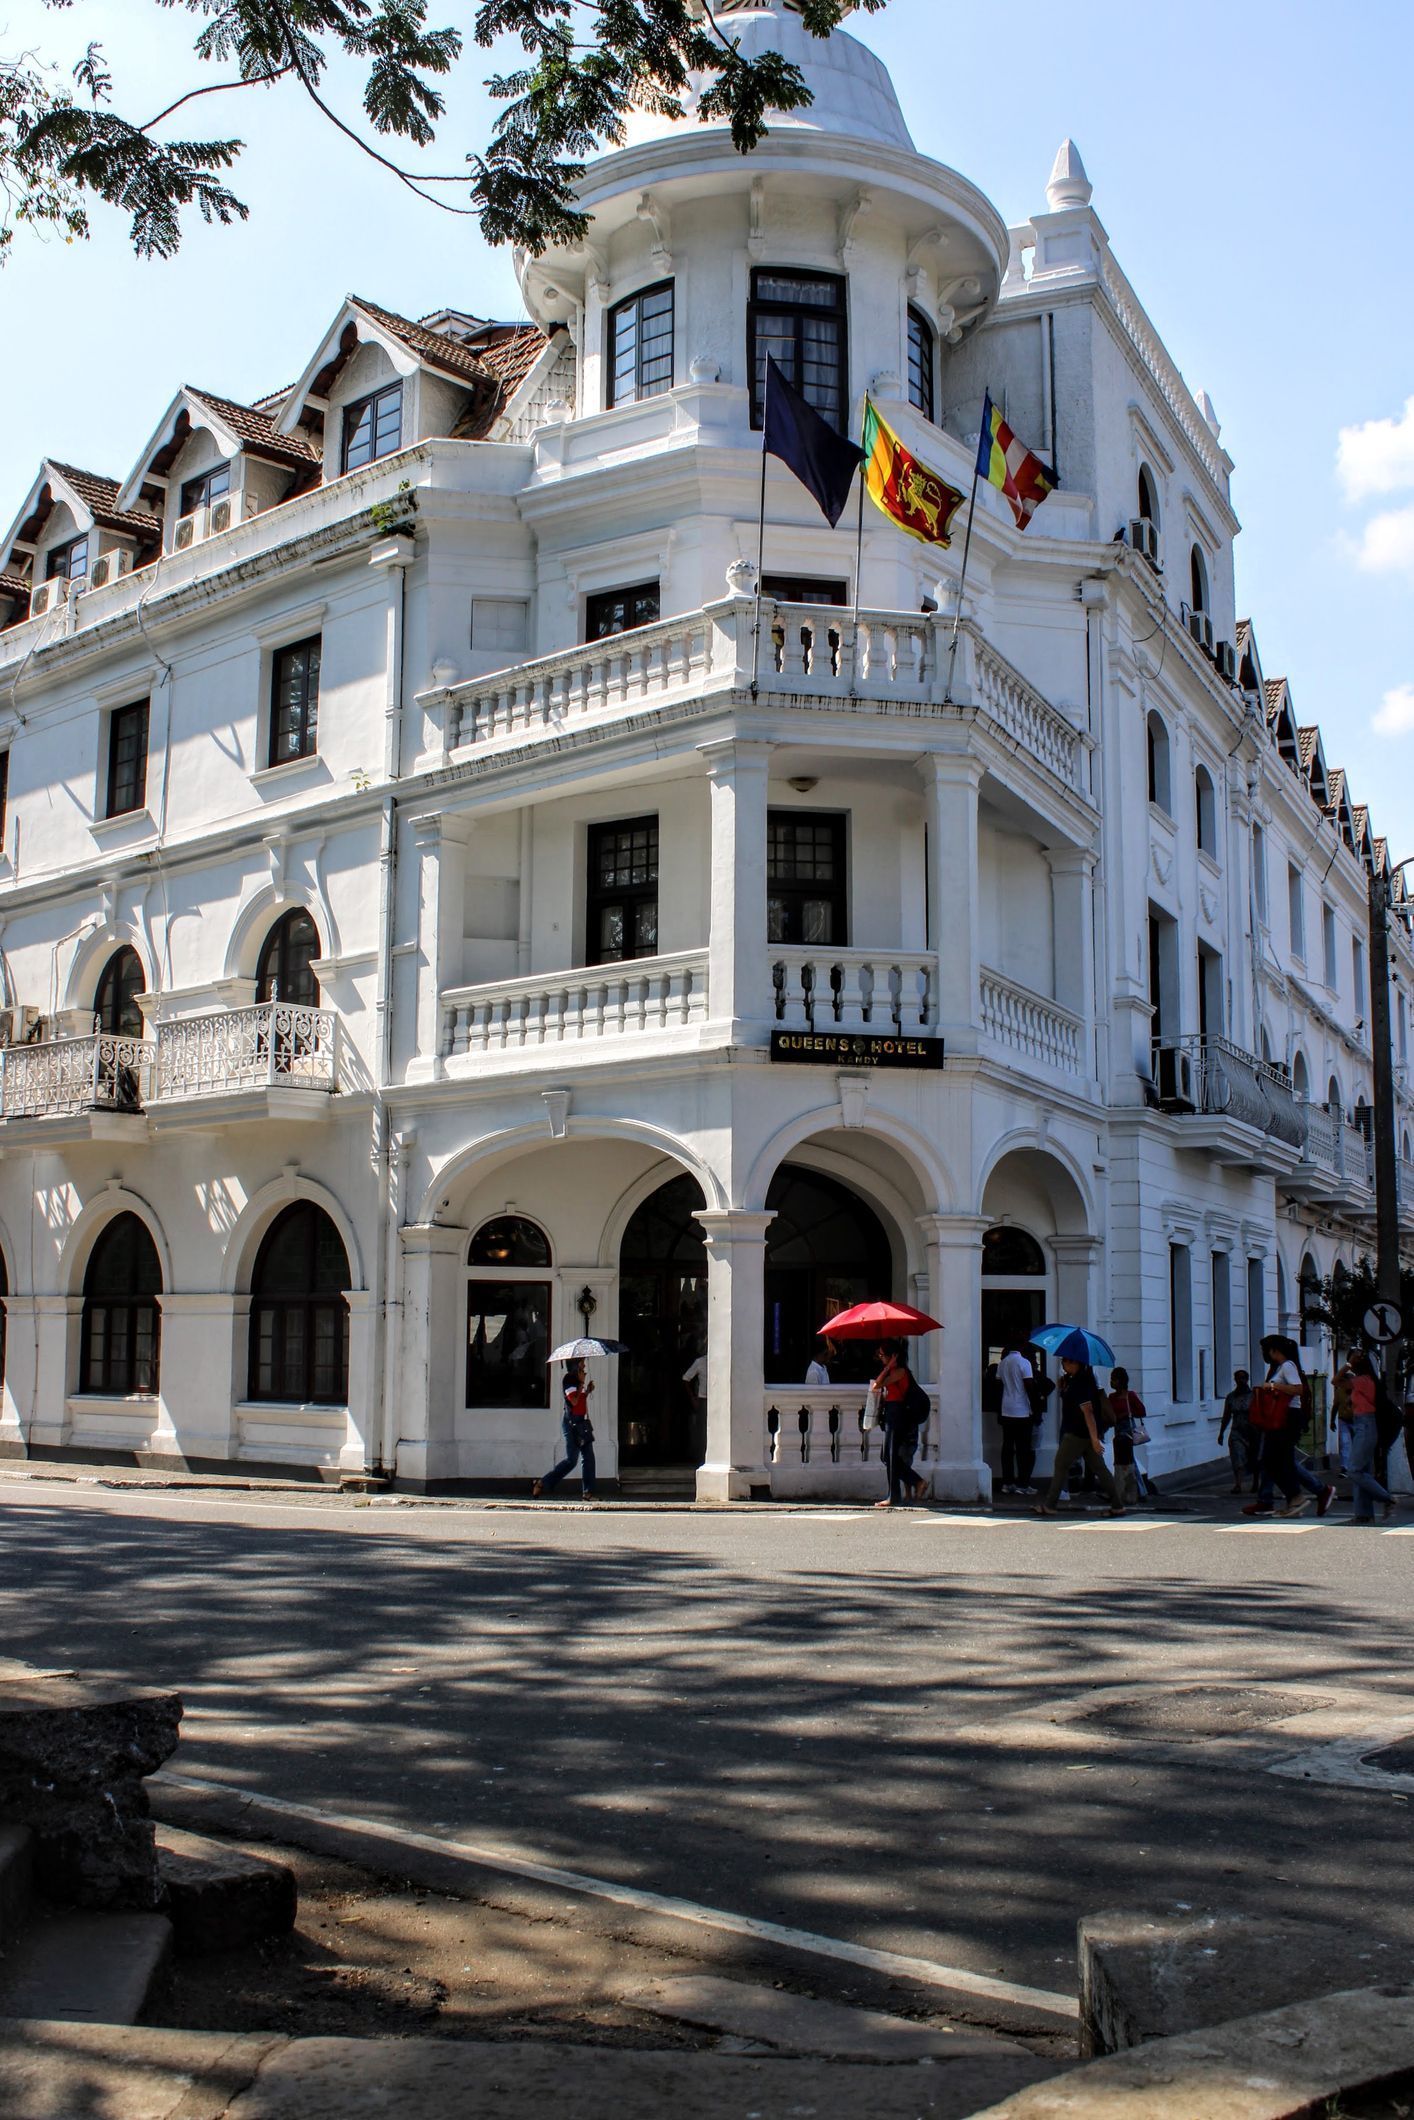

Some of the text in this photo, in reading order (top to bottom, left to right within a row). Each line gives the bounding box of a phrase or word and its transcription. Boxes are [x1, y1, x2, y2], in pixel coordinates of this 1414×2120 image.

[778, 1036, 927, 1055] QUEENS HOTEL
[837, 1055, 879, 1065] KANDY
